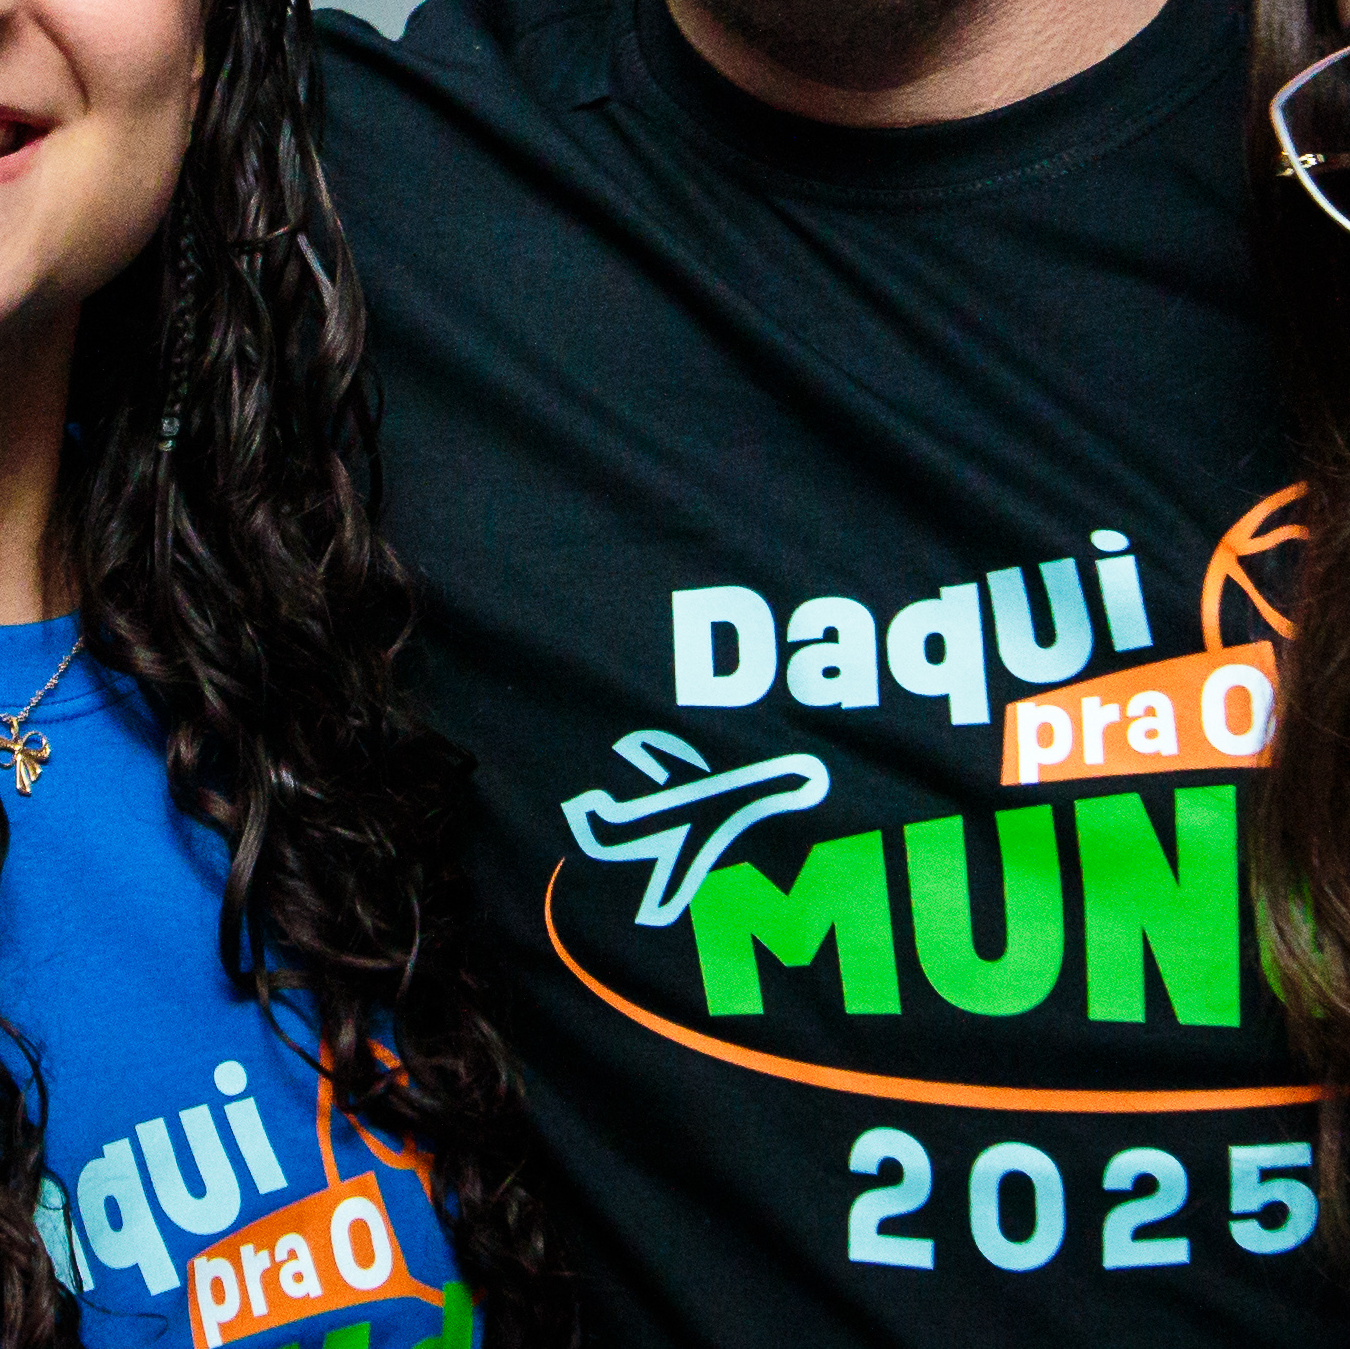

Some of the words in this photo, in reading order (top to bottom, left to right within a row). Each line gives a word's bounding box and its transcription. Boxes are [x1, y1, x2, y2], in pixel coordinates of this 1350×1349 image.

[1015, 690, 1180, 785] pra
[688, 784, 1326, 1028] MUN
[847, 1127, 1318, 1272] 2025
[193, 1232, 324, 1349] pra
